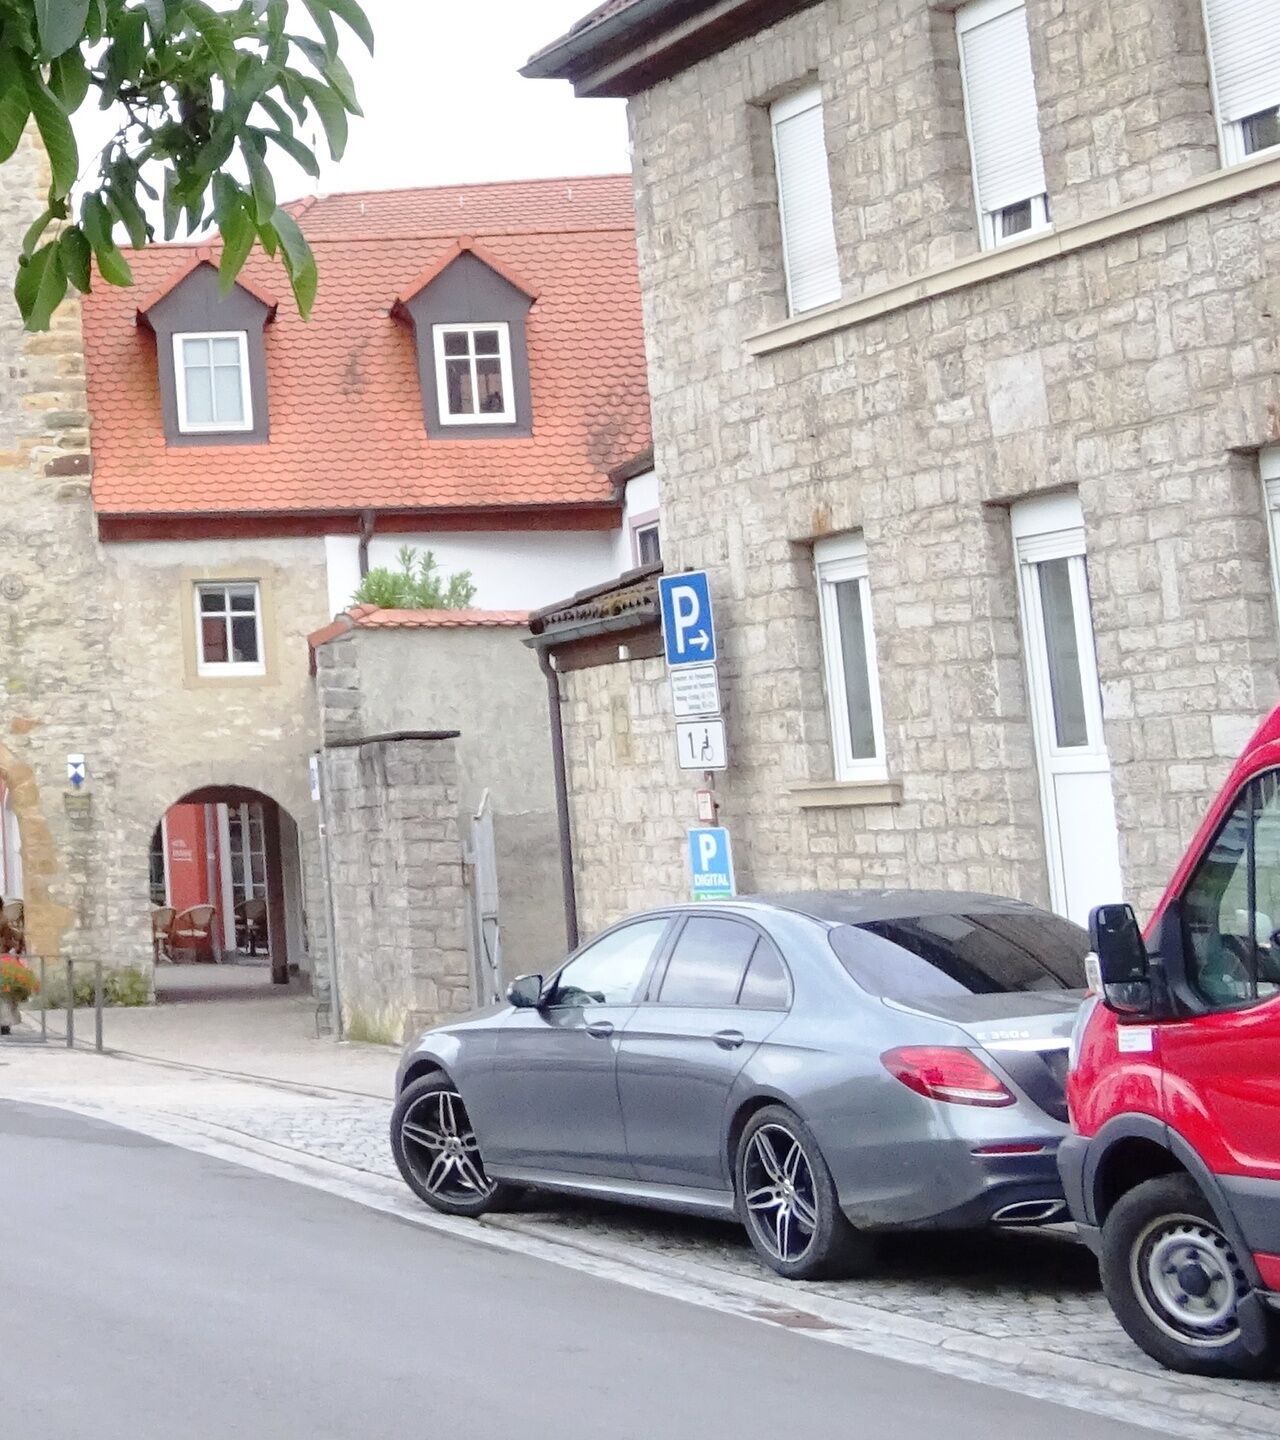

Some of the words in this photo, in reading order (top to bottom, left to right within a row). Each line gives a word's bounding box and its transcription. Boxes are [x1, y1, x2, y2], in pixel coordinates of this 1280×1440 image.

[671, 585, 700, 654] P
[688, 731, 696, 759] 1
[698, 833, 717, 872] P
[694, 873, 730, 887] DIGITAL
